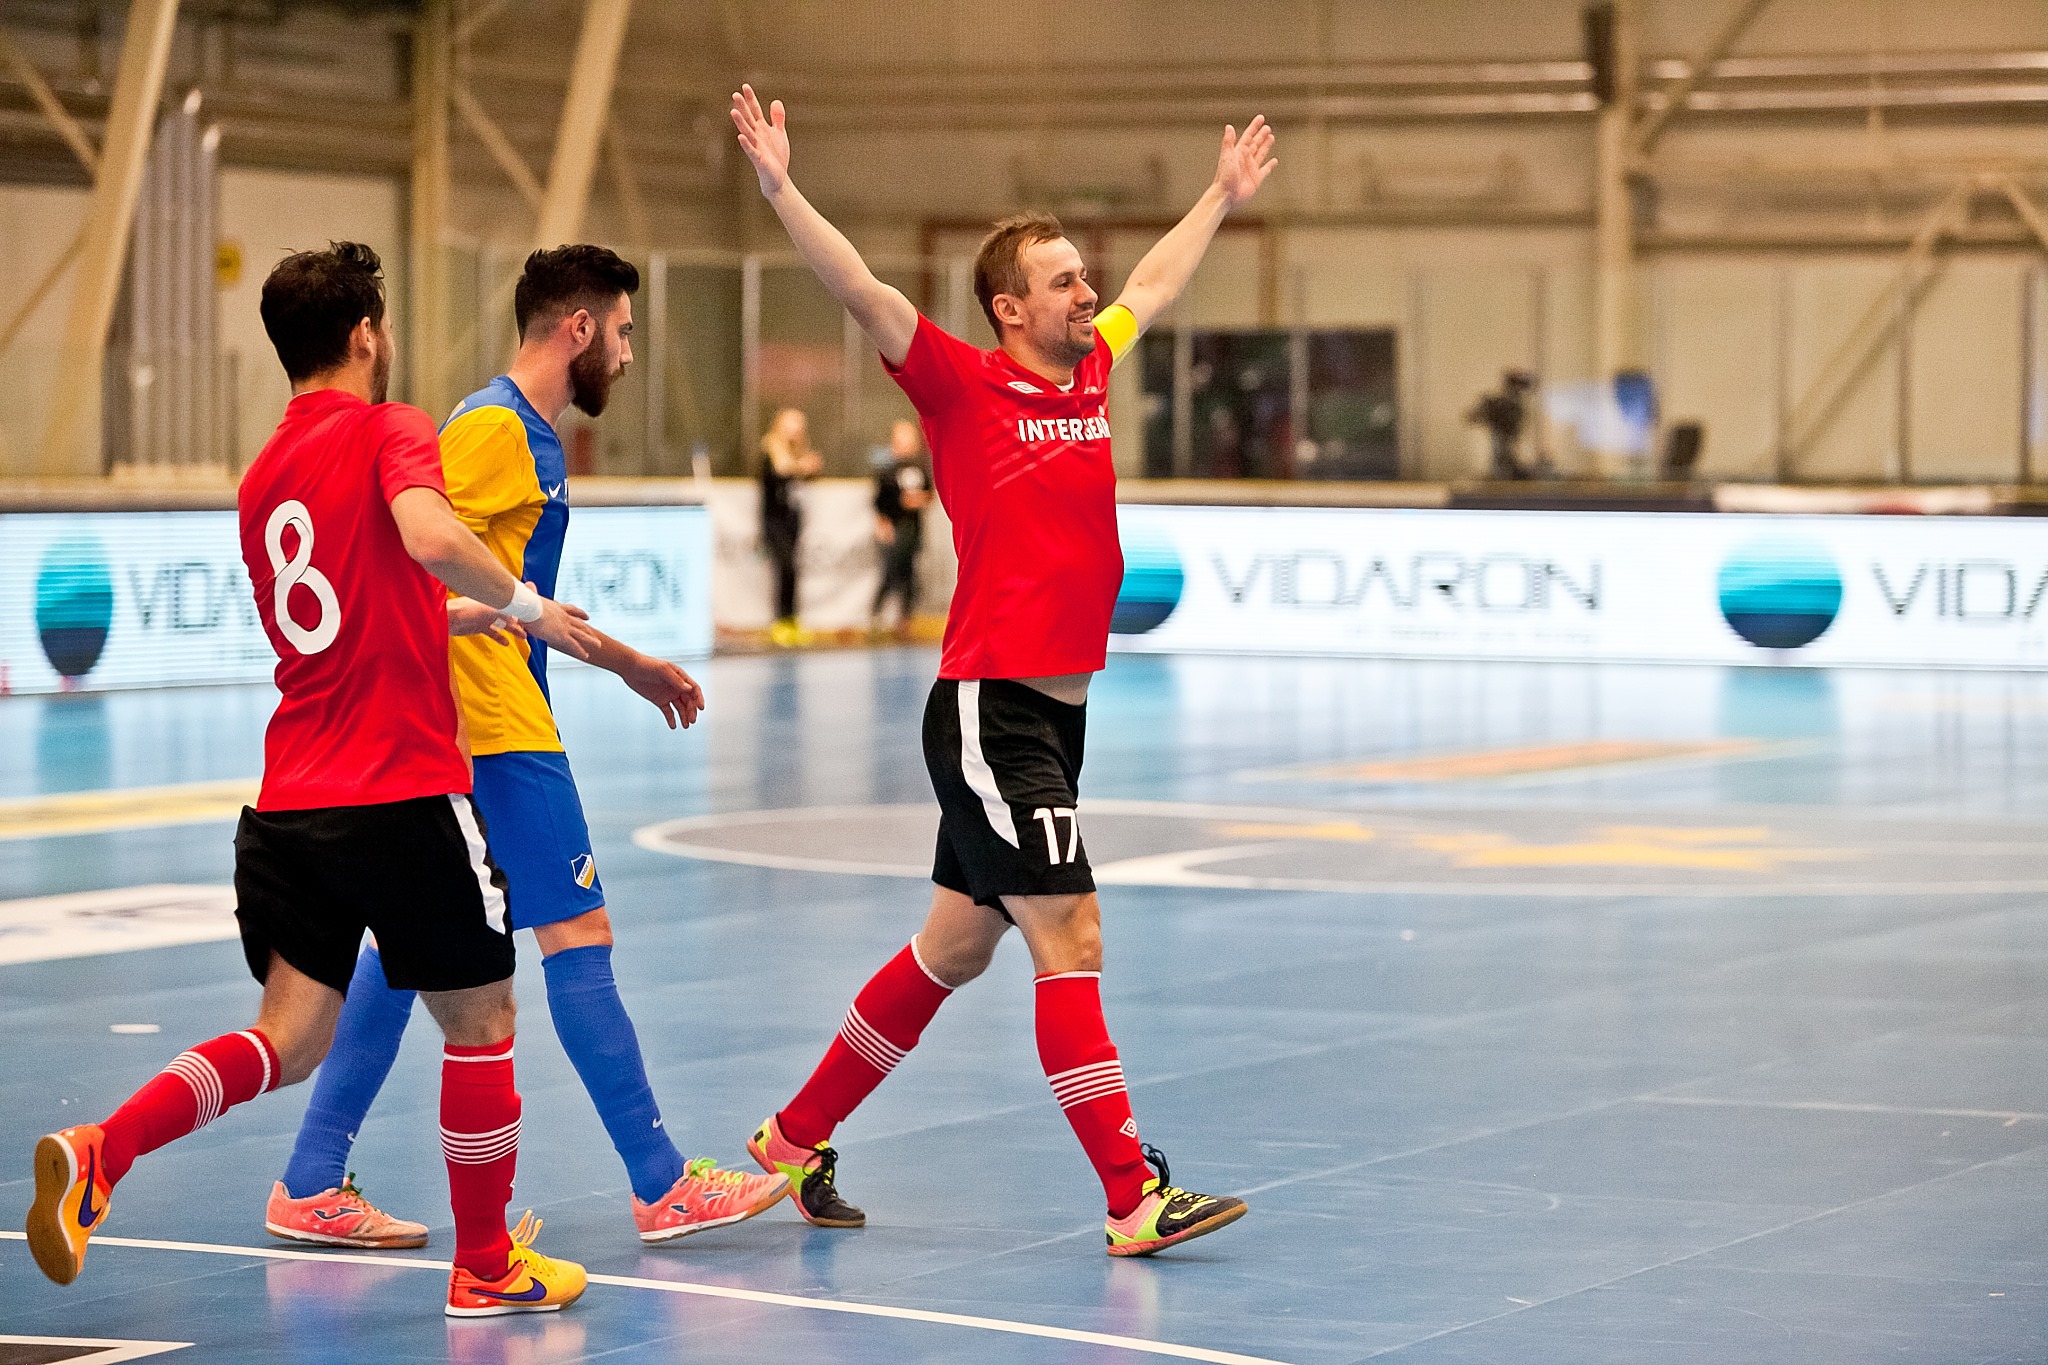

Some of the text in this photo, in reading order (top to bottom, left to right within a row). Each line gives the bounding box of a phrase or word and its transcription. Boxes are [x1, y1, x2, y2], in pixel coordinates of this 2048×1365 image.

[265, 500, 341, 655] 8
[1211, 551, 1602, 610] VIDARON
[1033, 808, 1078, 865] 17
